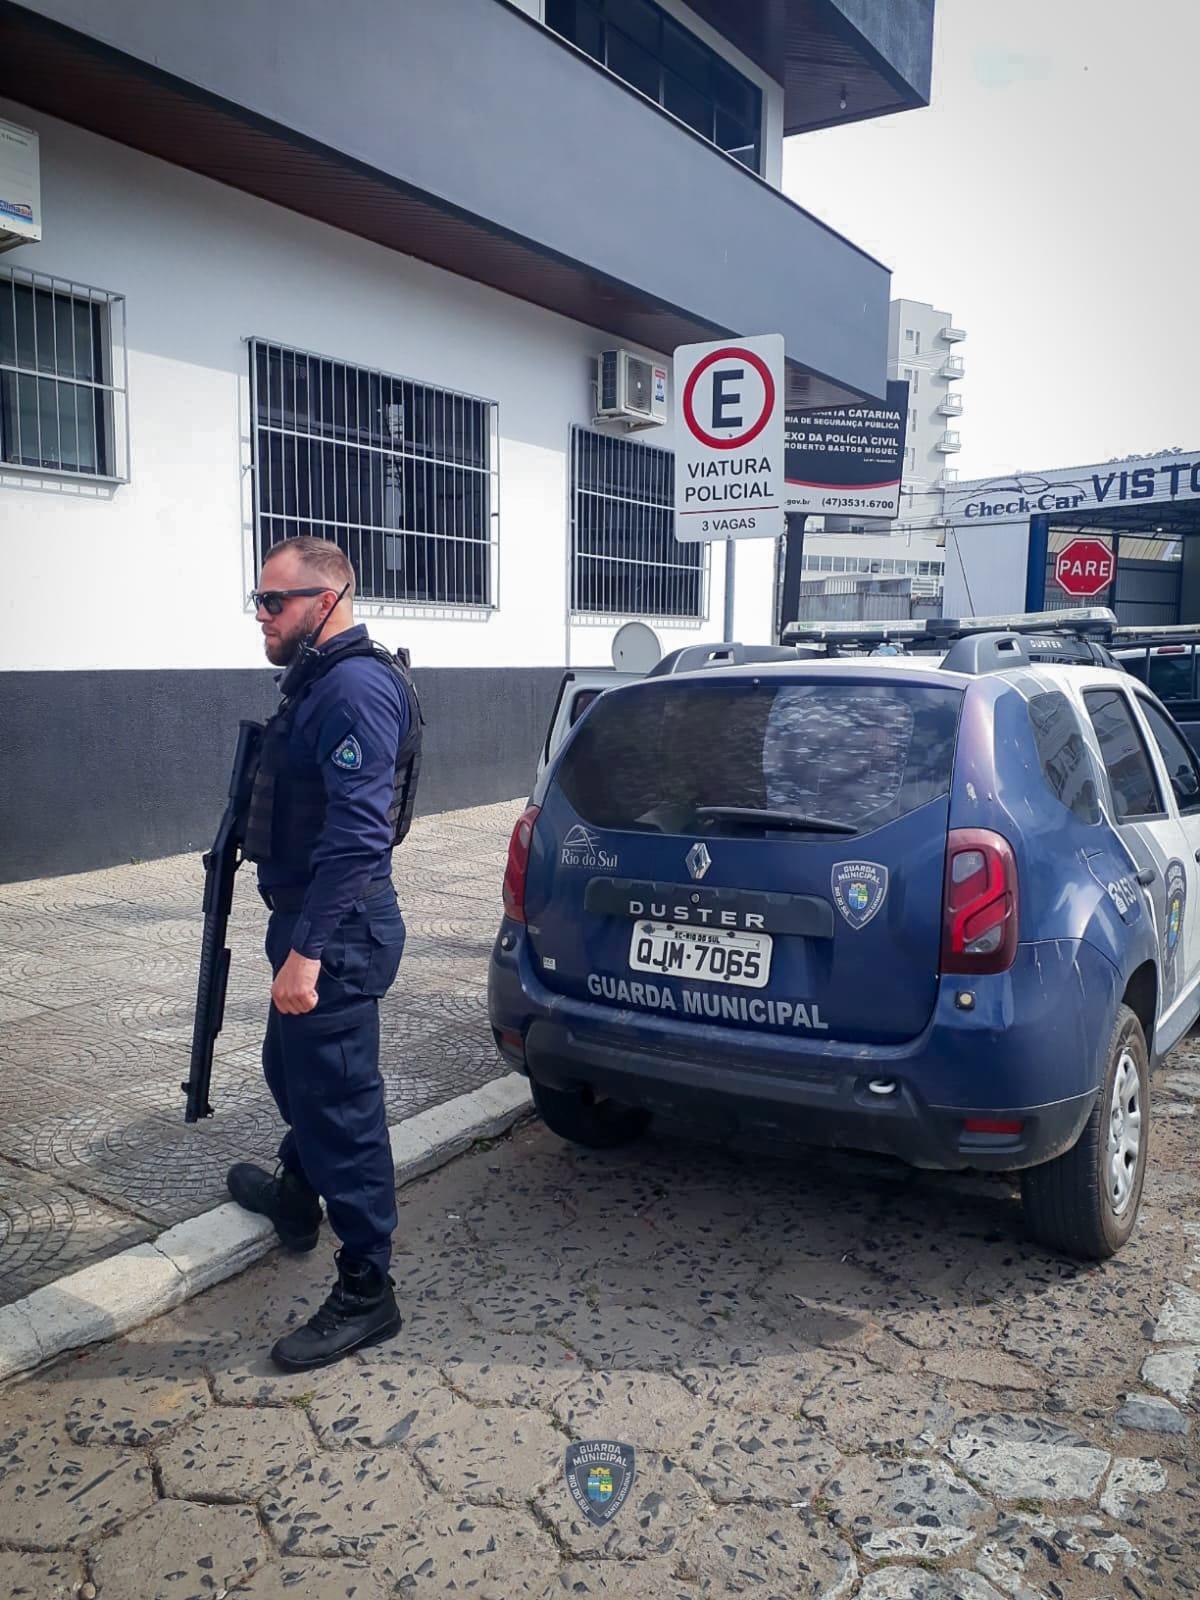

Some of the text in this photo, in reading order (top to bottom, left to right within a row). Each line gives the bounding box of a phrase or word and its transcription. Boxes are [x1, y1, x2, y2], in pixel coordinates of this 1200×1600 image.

[711, 369, 744, 428] E
[848, 409, 901, 420] CATARINA
[814, 418, 863, 428] SEGURANÇA
[809, 433, 823, 442] DA
[826, 433, 868, 445] POLÍCIA
[871, 437, 899, 447] CIVIL
[828, 445, 863, 453] BASTOS
[865, 447, 898, 455] MIGUEL
[687, 457, 772, 479] VIATURA
[685, 481, 774, 502] POLICIAL
[822, 498, 895, 509] (47)3531.6700
[964, 494, 1085, 518] Check-Car
[702, 517, 756, 531] 3 VAGAS
[1059, 560, 1110, 577] PARE
[1030, 639, 1063, 649] DUSTER
[561, 848, 618, 867] Rio do Sul
[843, 864, 877, 875] GUARDA
[838, 871, 880, 884] MUNICIPAL
[629, 901, 765, 929] DUSTER
[587, 974, 829, 1030] GUARDA MUNICIPAL
